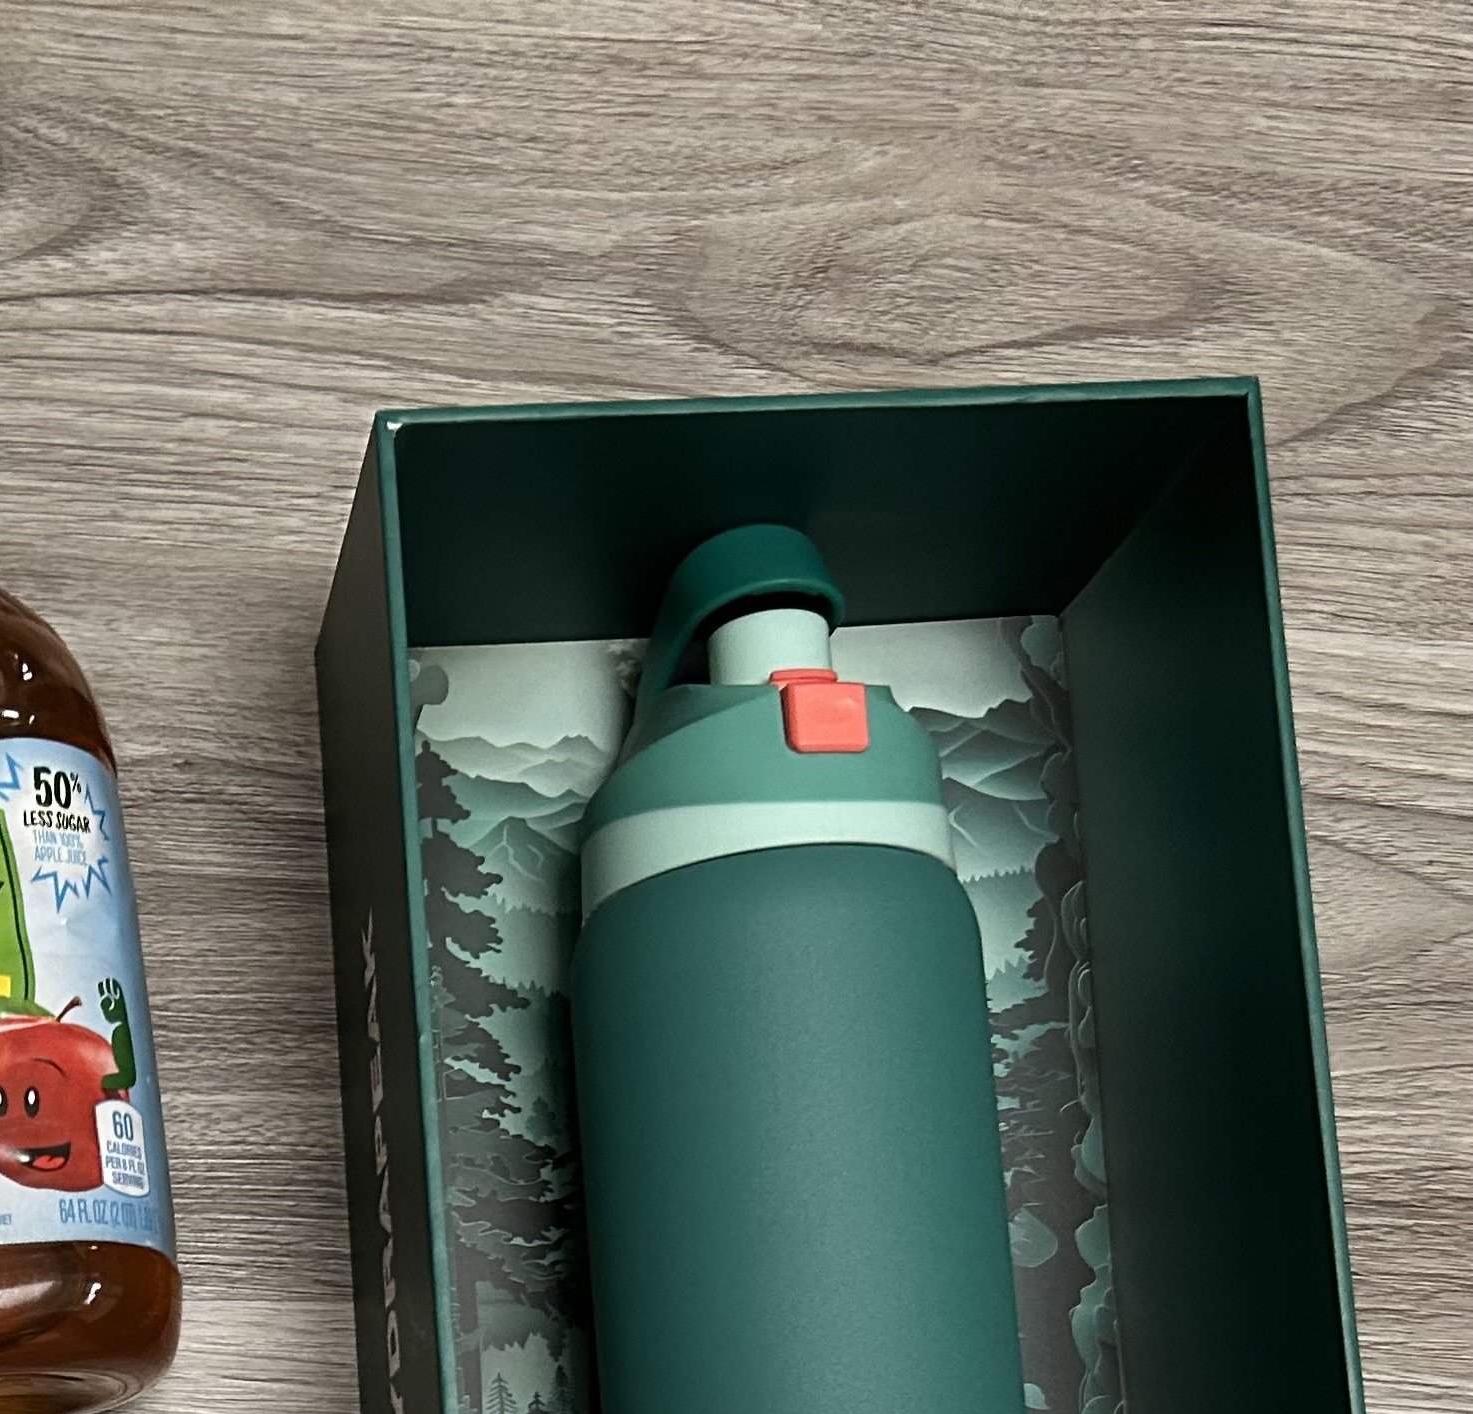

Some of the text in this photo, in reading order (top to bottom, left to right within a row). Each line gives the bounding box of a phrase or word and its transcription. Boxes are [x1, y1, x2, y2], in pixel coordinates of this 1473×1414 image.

[33, 766, 82, 809] 50%
[23, 810, 91, 833] LESS SUGAR
[112, 1110, 134, 1141] 60
